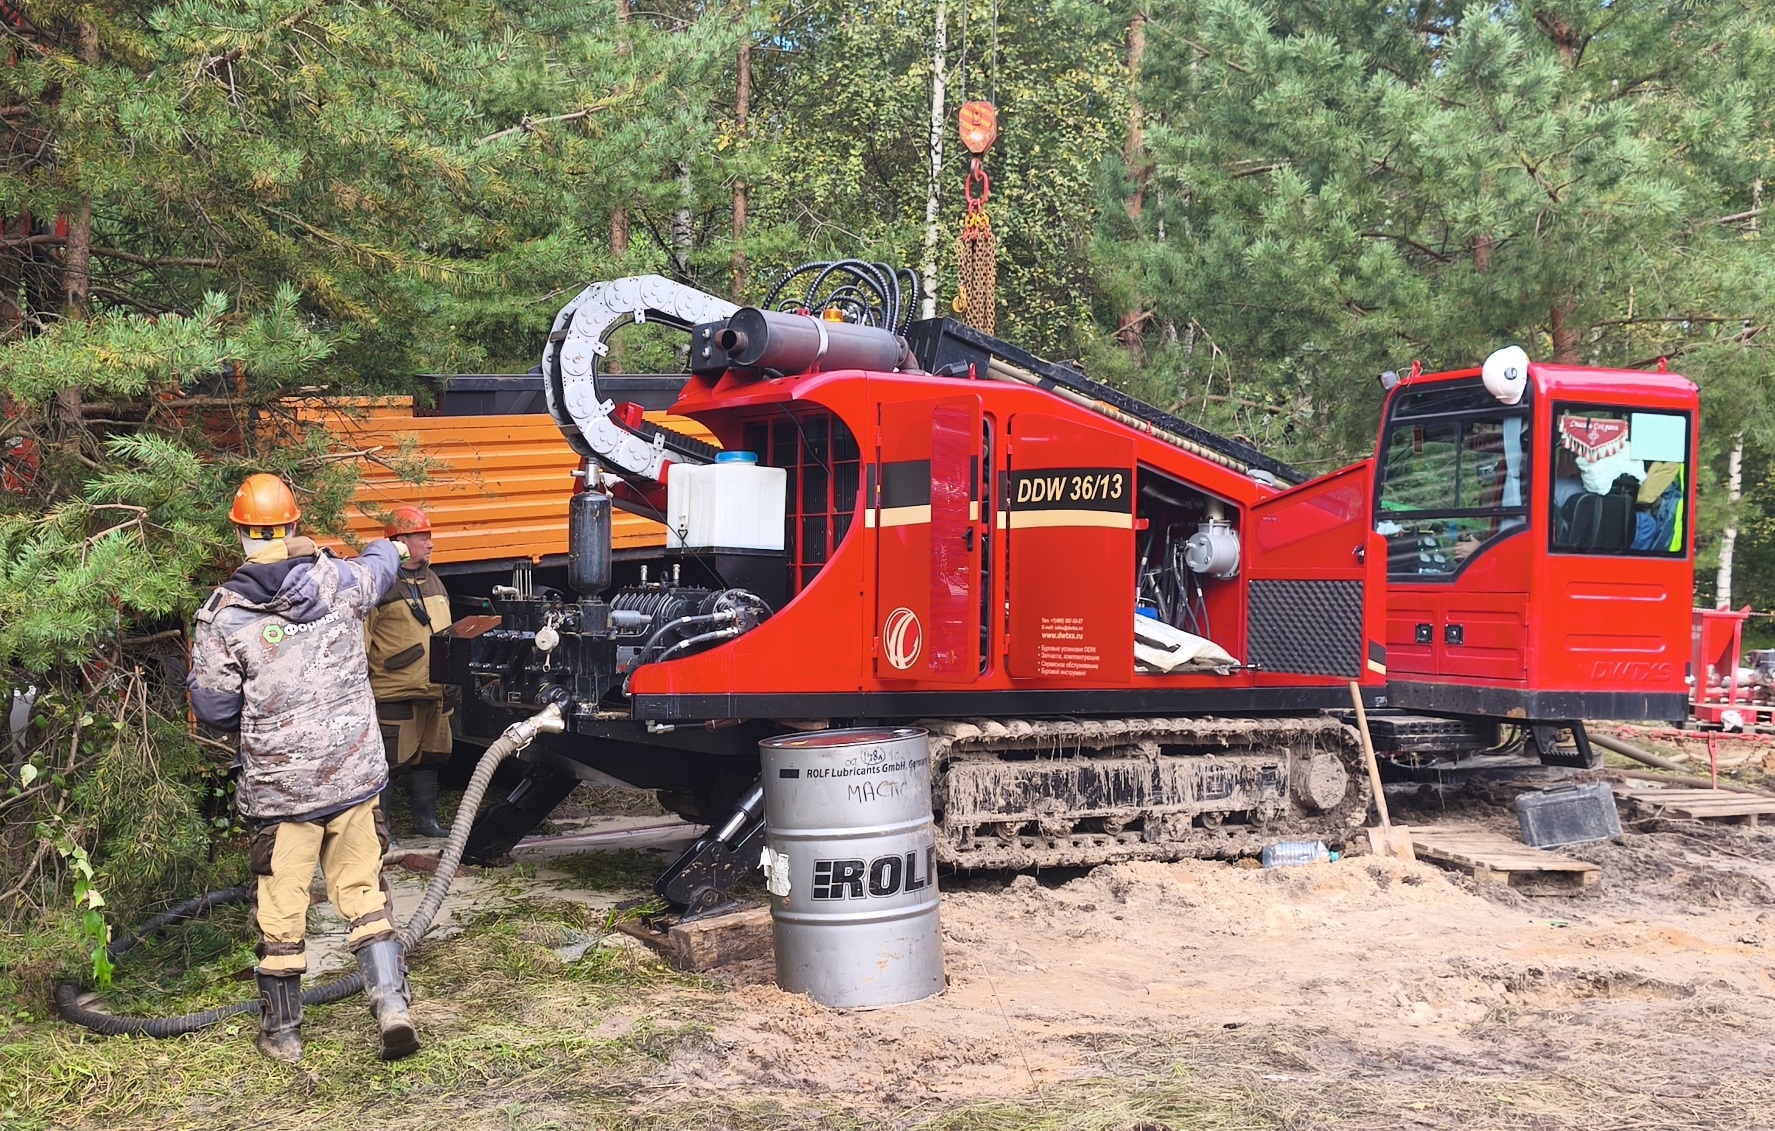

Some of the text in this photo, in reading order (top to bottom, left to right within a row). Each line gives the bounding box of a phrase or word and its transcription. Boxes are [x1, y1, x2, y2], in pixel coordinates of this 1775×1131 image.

[1017, 473, 1123, 503] DDW 36/13
[283, 610, 340, 636] Формат
[1041, 631, 1084, 640] www.dwtxs.ru
[806, 768, 830, 778] ROLF
[831, 765, 881, 777] Lubricants
